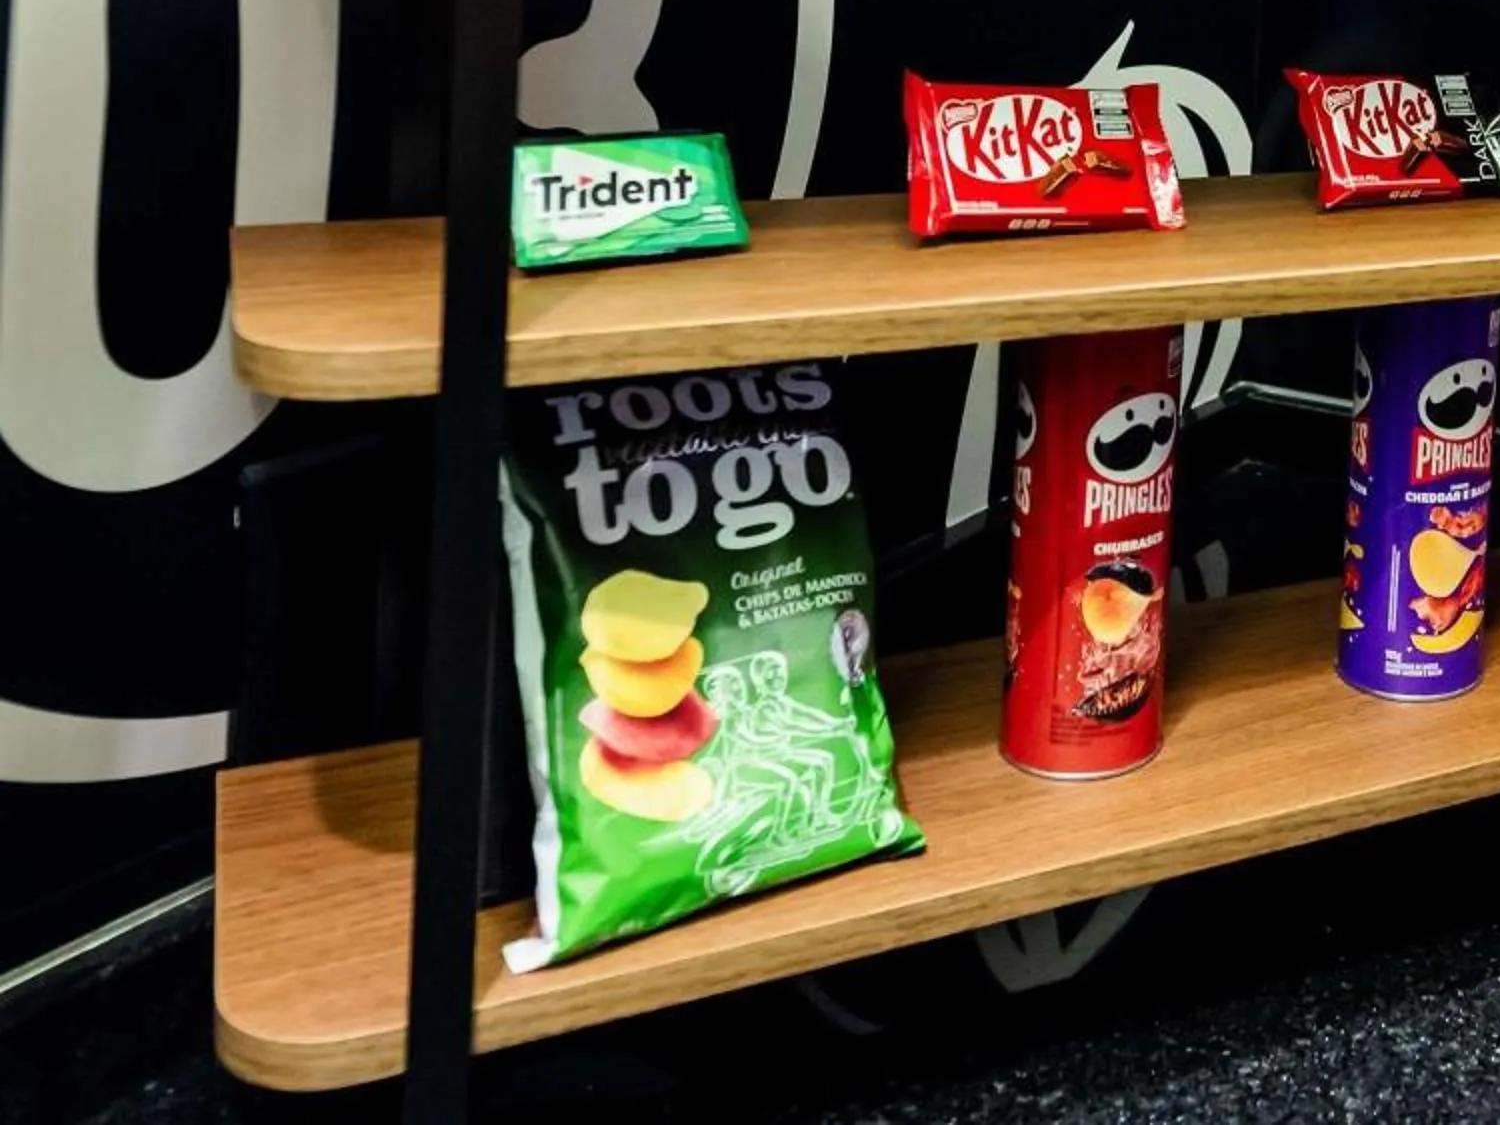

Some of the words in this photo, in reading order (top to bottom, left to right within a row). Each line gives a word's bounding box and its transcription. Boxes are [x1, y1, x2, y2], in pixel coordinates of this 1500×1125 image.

[962, 97, 1075, 179] KitKat
[1342, 82, 1432, 156] KitKat
[1464, 118, 1496, 179] DARK
[533, 168, 693, 212] Trident
[544, 362, 833, 446] roots
[1415, 426, 1493, 479] PRINGLES
[564, 446, 697, 546] to
[712, 434, 851, 550] go
[1083, 465, 1173, 528] PRINGLES
[735, 591, 781, 611] CHIPS
[783, 584, 802, 599] DE
